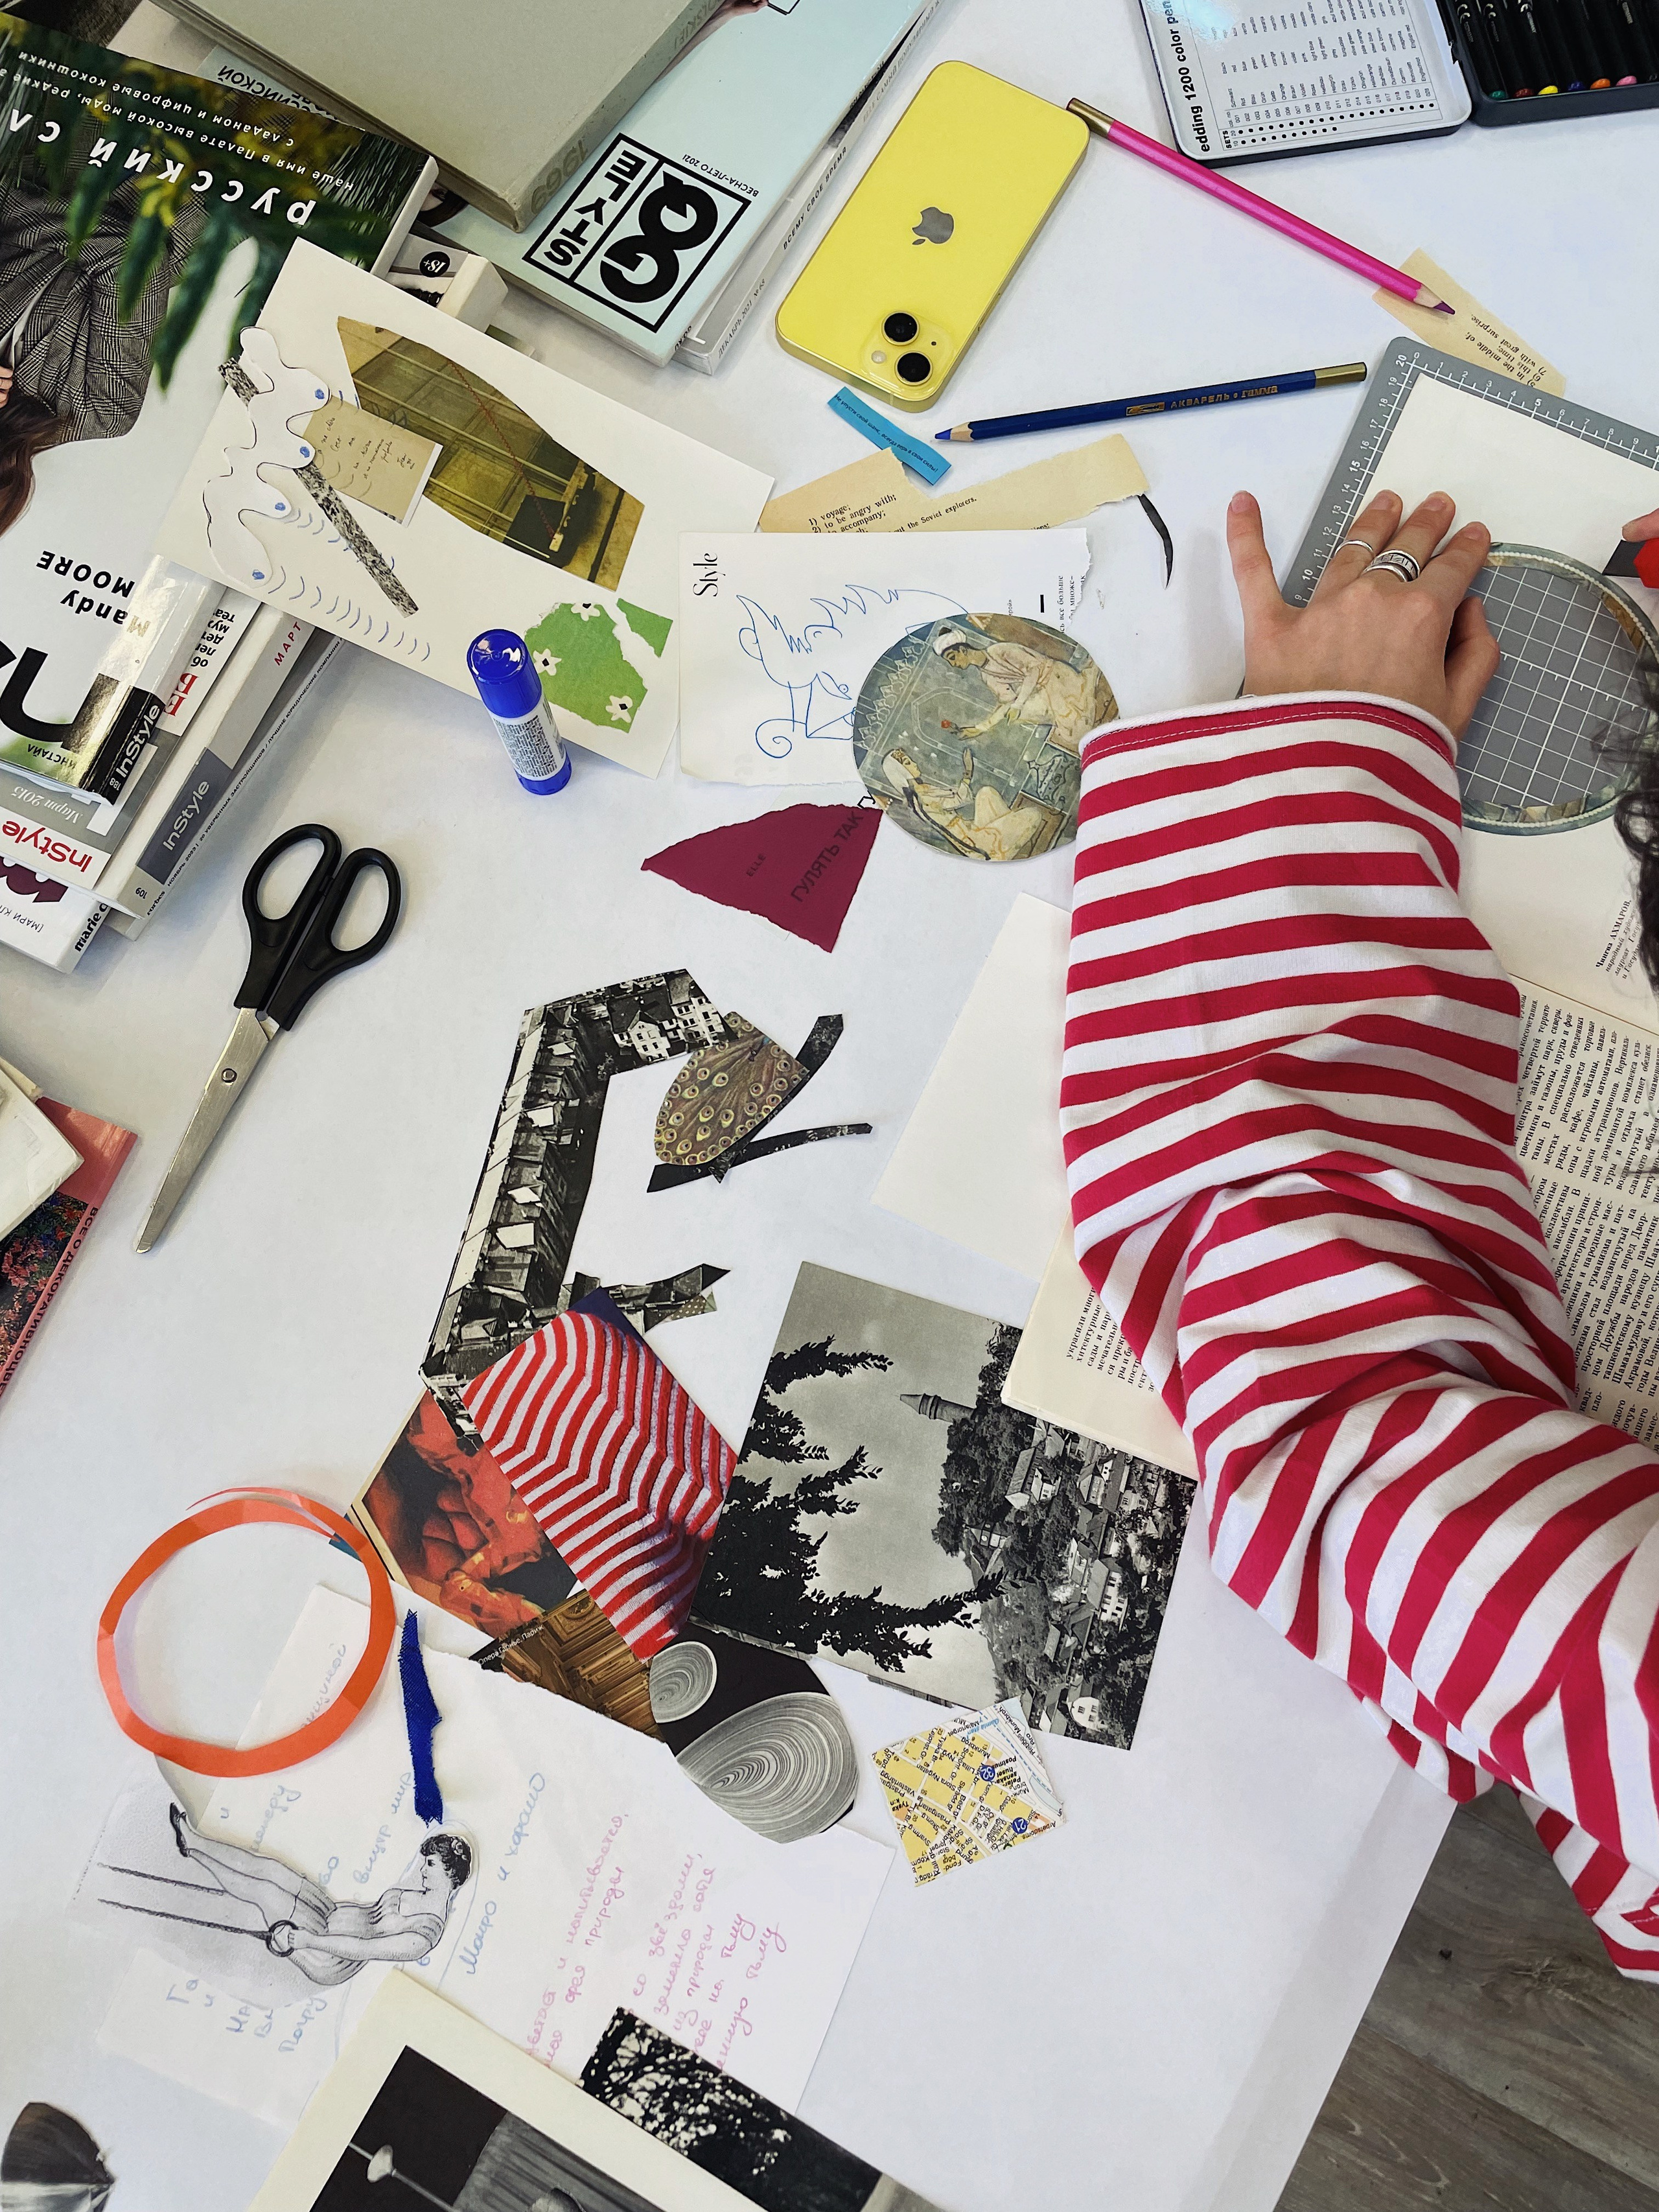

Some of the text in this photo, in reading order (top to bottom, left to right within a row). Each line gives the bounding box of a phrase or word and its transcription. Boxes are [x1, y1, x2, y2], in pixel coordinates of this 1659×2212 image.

[1170, 29, 1186, 62] color
[14, 73, 70, 98] редкие
[19, 52, 106, 87] кокошники
[1178, 67, 1196, 100] 1200
[1386, 58, 1397, 85] Dunkelbraun
[78, 94, 121, 115] моды,
[113, 84, 191, 113] цифровые
[1228, 88, 1236, 108] Schwarz
[128, 112, 194, 137] высокой
[213, 115, 280, 141] ладаном
[1191, 106, 1210, 152] edding
[1223, 131, 1232, 148] SETS
[201, 135, 255, 159] Палате
[88, 136, 317, 227] русский
[277, 159, 305, 174] имя
[313, 171, 354, 192] наше
[682, 154, 759, 196] ВЕСНА-ЛЕТО 2021
[544, 149, 718, 303] GQ STYLE
[719, 146, 848, 358] ДЕКАБРЬ 2021 ВСЕМУ СВОЕ ВРЕМЯ
[1396, 355, 1406, 367] 20
[1470, 314, 1546, 375] 7) with great surprise.
[1478, 342, 1501, 361] middle
[1497, 346, 1514, 362] time;
[1503, 362, 1514, 372] the
[1517, 371, 1524, 380] In
[1518, 362, 1531, 374] this
[1171, 392, 1230, 408] АКВАРЕЛЬ
[841, 401, 857, 414] упусти
[857, 414, 868, 423] свой
[868, 423, 880, 434] шанс,
[881, 434, 897, 445] всегда
[912, 452, 923, 461] свои
[923, 460, 938, 472] силы!
[1360, 441, 1369, 449] 16
[1349, 461, 1360, 471] 15
[813, 524, 821, 533] 2)
[850, 506, 874, 518] angry
[875, 495, 896, 507] with;
[820, 506, 853, 520] voyage;
[838, 510, 885, 532] accompany;
[921, 511, 942, 523] Soviet
[946, 498, 977, 513] explorers.
[36, 551, 135, 598] MOORE
[692, 553, 726, 597] Style
[60, 588, 152, 635] Mandy
[274, 622, 301, 666] МАРТ
[26, 744, 77, 770] ИНСТАЙЛ
[110, 703, 161, 790] 188 InStyle
[168, 863, 185, 886] НОЯБРЬ
[205, 798, 231, 833] УВЕРЕННЫХ
[231, 749, 264, 797] ЗАСТРОЙЩИКОВ
[268, 719, 286, 743] ЛУЧШИЕ
[286, 674, 317, 718] ЮРИДИЧЕСКИЕ
[317, 641, 340, 673] КОМПАНИИ
[11, 786, 83, 823] Март 2015
[162, 780, 210, 851] InStyle
[2, 819, 92, 872] InStyle
[791, 811, 864, 903] ГУЛЯТЬ ТАК
[746, 852, 767, 878] ELLE
[135, 888, 147, 899] 109
[75, 912, 102, 953] marie
[1595, 900, 1631, 967] Чингиз АХМАРОВ.
[1606, 938, 1624, 972] народный
[1522, 1038, 1540, 1079] четвертей
[1597, 1048, 1616, 1095] автоматами,
[1549, 1065, 1572, 1114] специально
[1582, 1061, 1600, 1097] чайханы,
[1544, 1062, 1585, 1165] местах расположатся
[1594, 1082, 1619, 1142] аттракционов.
[1520, 1115, 1540, 1156] цветники
[1601, 1108, 1624, 1161] доминантой
[79, 1207, 99, 1236] ВСЕ
[73, 1239, 81, 1249] О
[1600, 1227, 1634, 1290] воздвигнутый
[1558, 1236, 1587, 1294] архитекторы
[1599, 1268, 1638, 1352] Дружбы народов
[1067, 1316, 1085, 1359] украсили
[1077, 1305, 1101, 1360] хитектурные
[1576, 1320, 1605, 1372] просторной
[1087, 1345, 1098, 1366] сады
[476, 1624, 545, 1666] Опера Гарнье, Париж
[917, 1758, 956, 1791] Stora Nygatan
[959, 1762, 975, 1774] Lilla
[979, 1764, 995, 1780] 32
[1010, 1815, 1028, 1832] 21
